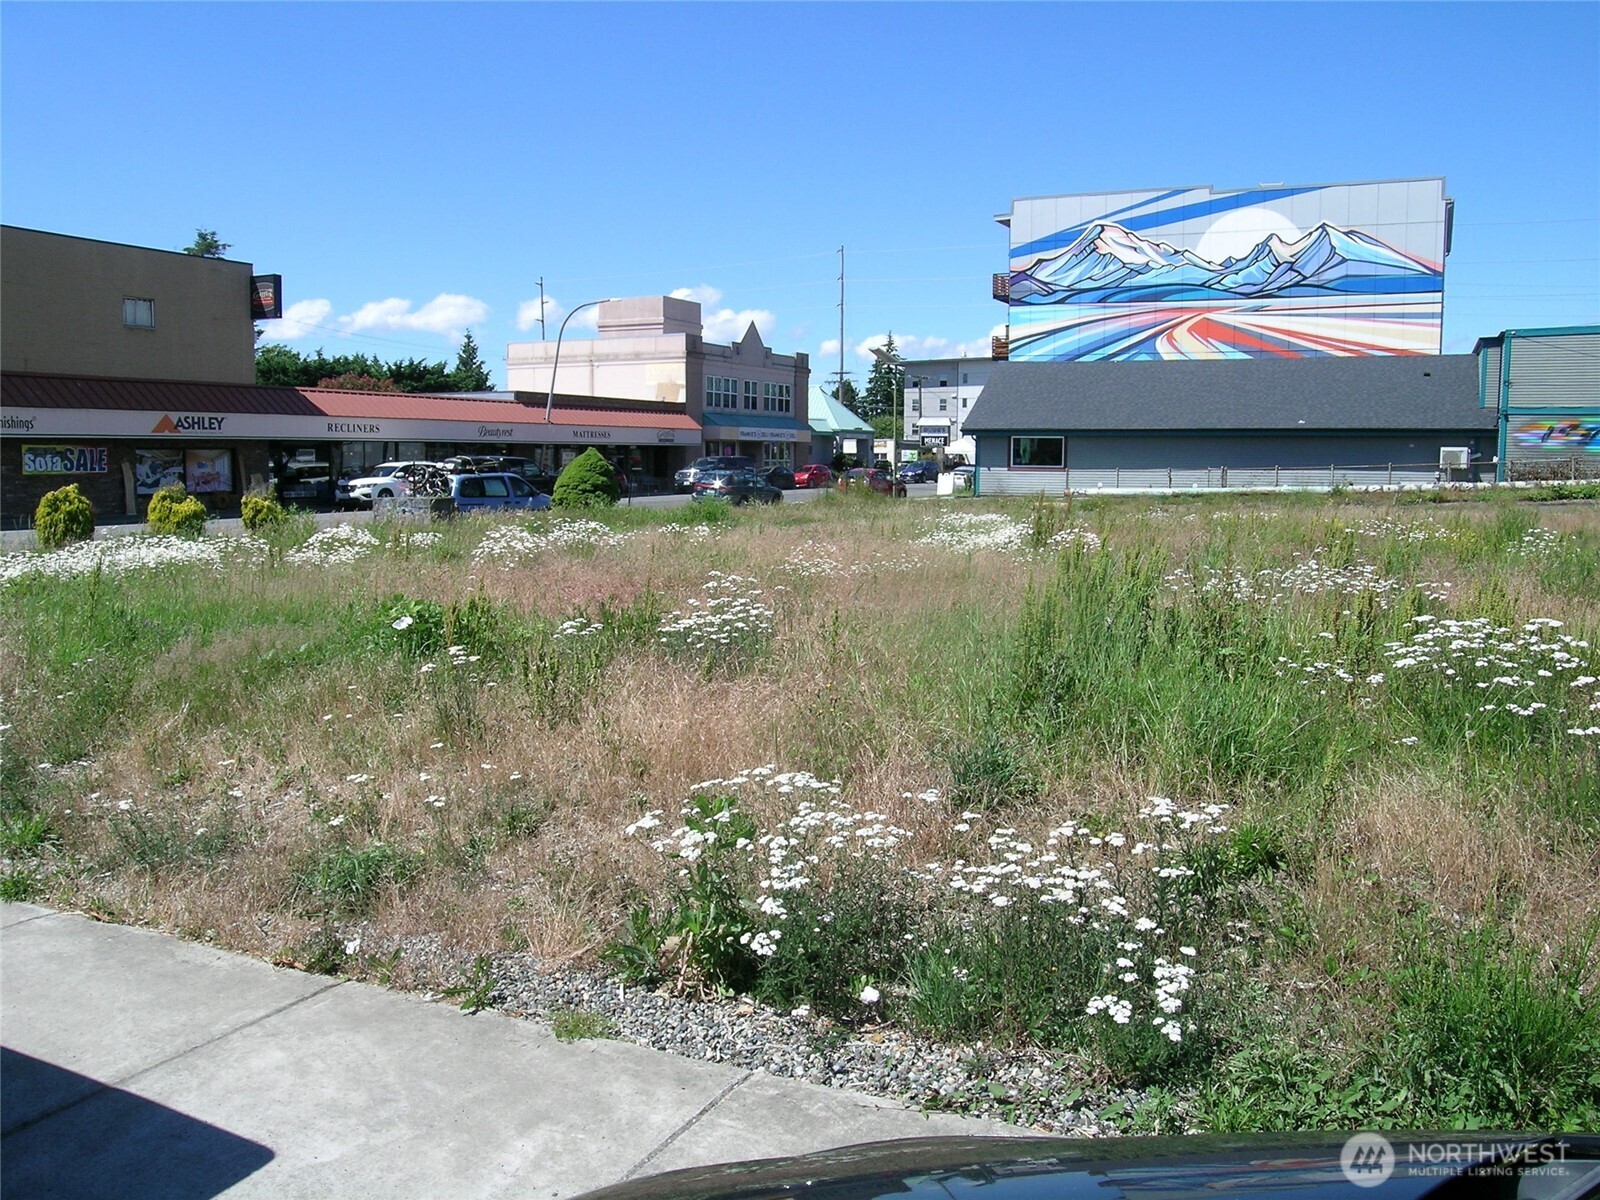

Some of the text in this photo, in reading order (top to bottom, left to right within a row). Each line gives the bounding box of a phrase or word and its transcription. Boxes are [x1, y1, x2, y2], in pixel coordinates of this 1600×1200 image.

[174, 415, 225, 431] ASHLEY
[327, 422, 381, 434] RECLINERS
[477, 425, 514, 438] Beautyrest
[572, 430, 612, 439] MATTRESSES
[24, 446, 108, 473] Sofa SALE
